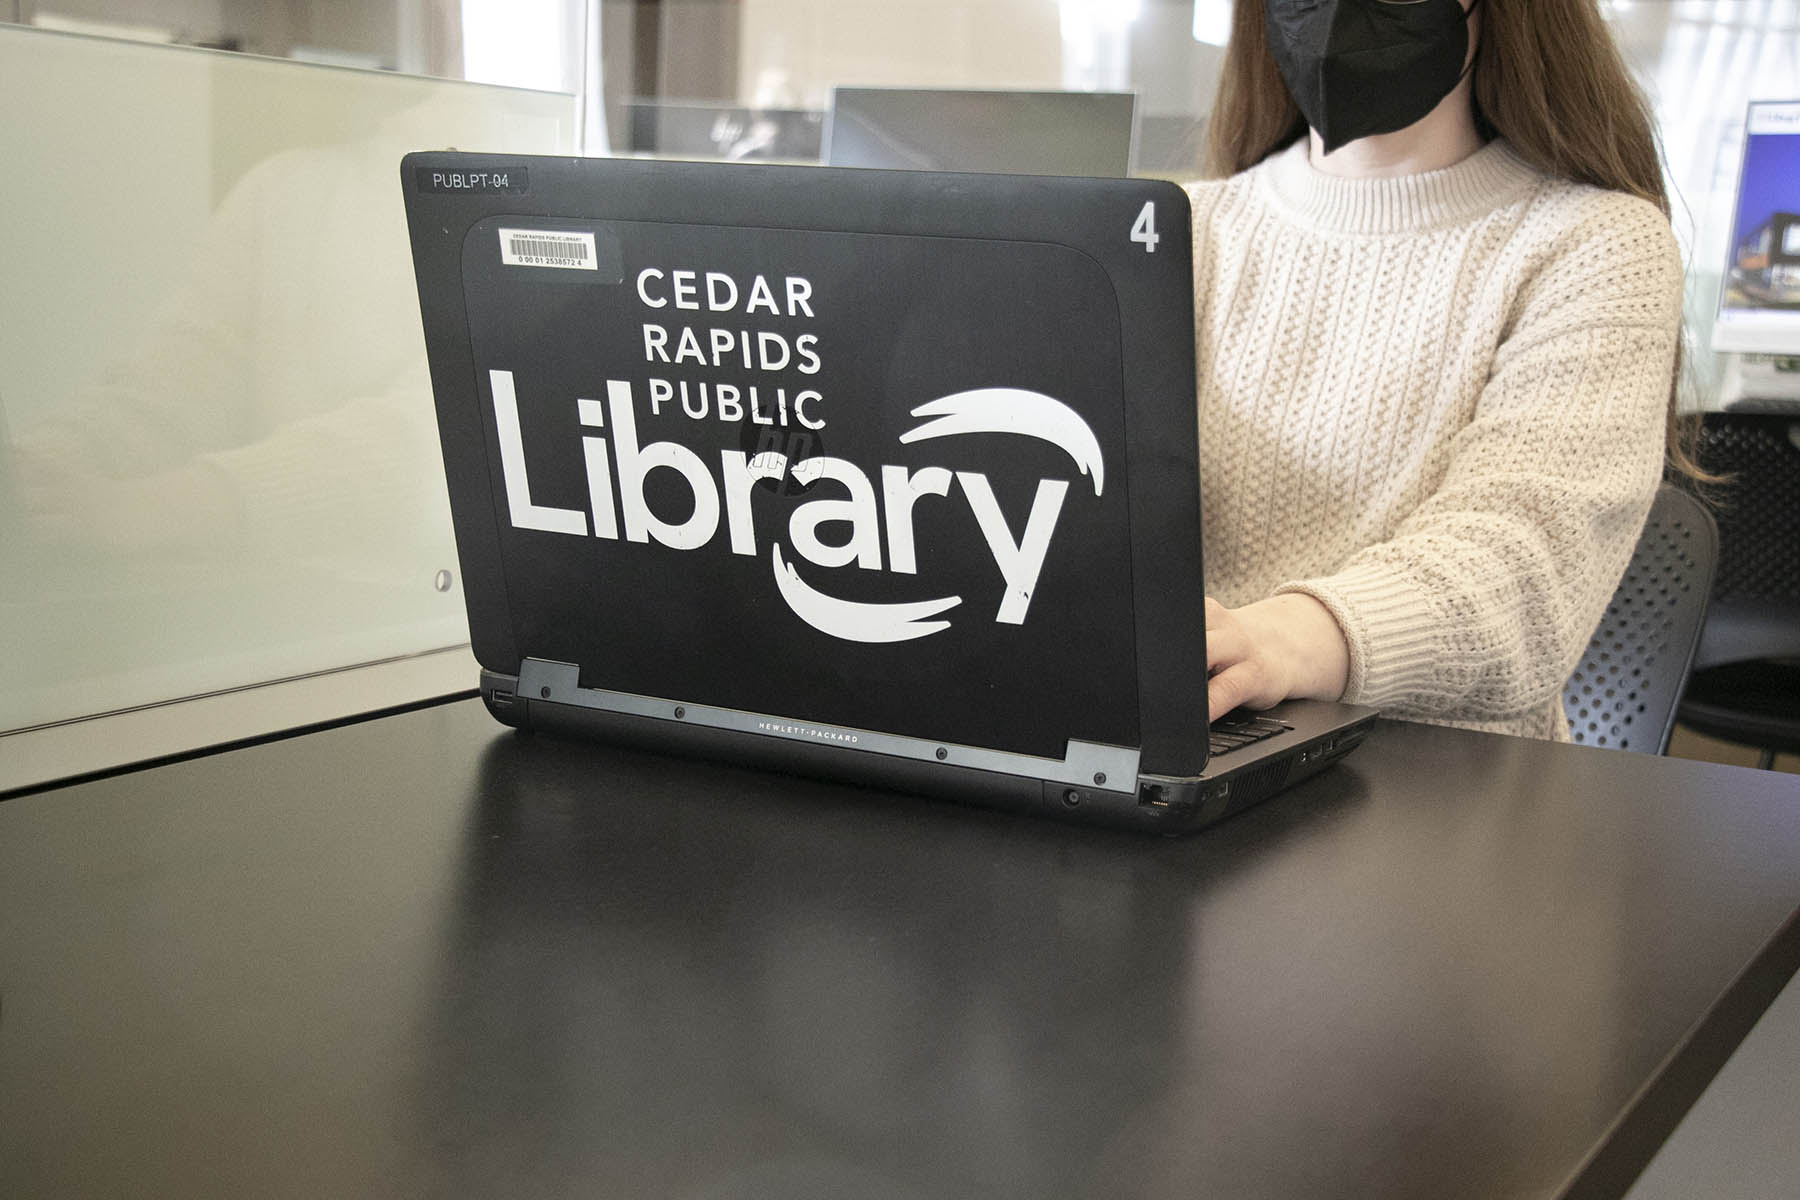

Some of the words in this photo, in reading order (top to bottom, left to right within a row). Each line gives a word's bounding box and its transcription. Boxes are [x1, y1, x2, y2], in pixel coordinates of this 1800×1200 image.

[433, 173, 509, 188] PUBLPT-04
[1130, 201, 1160, 253] 4
[636, 268, 815, 318] CEDAR
[643, 323, 822, 375] RAPIDS
[648, 378, 827, 431] PUBLIC
[489, 369, 1070, 625] Library
